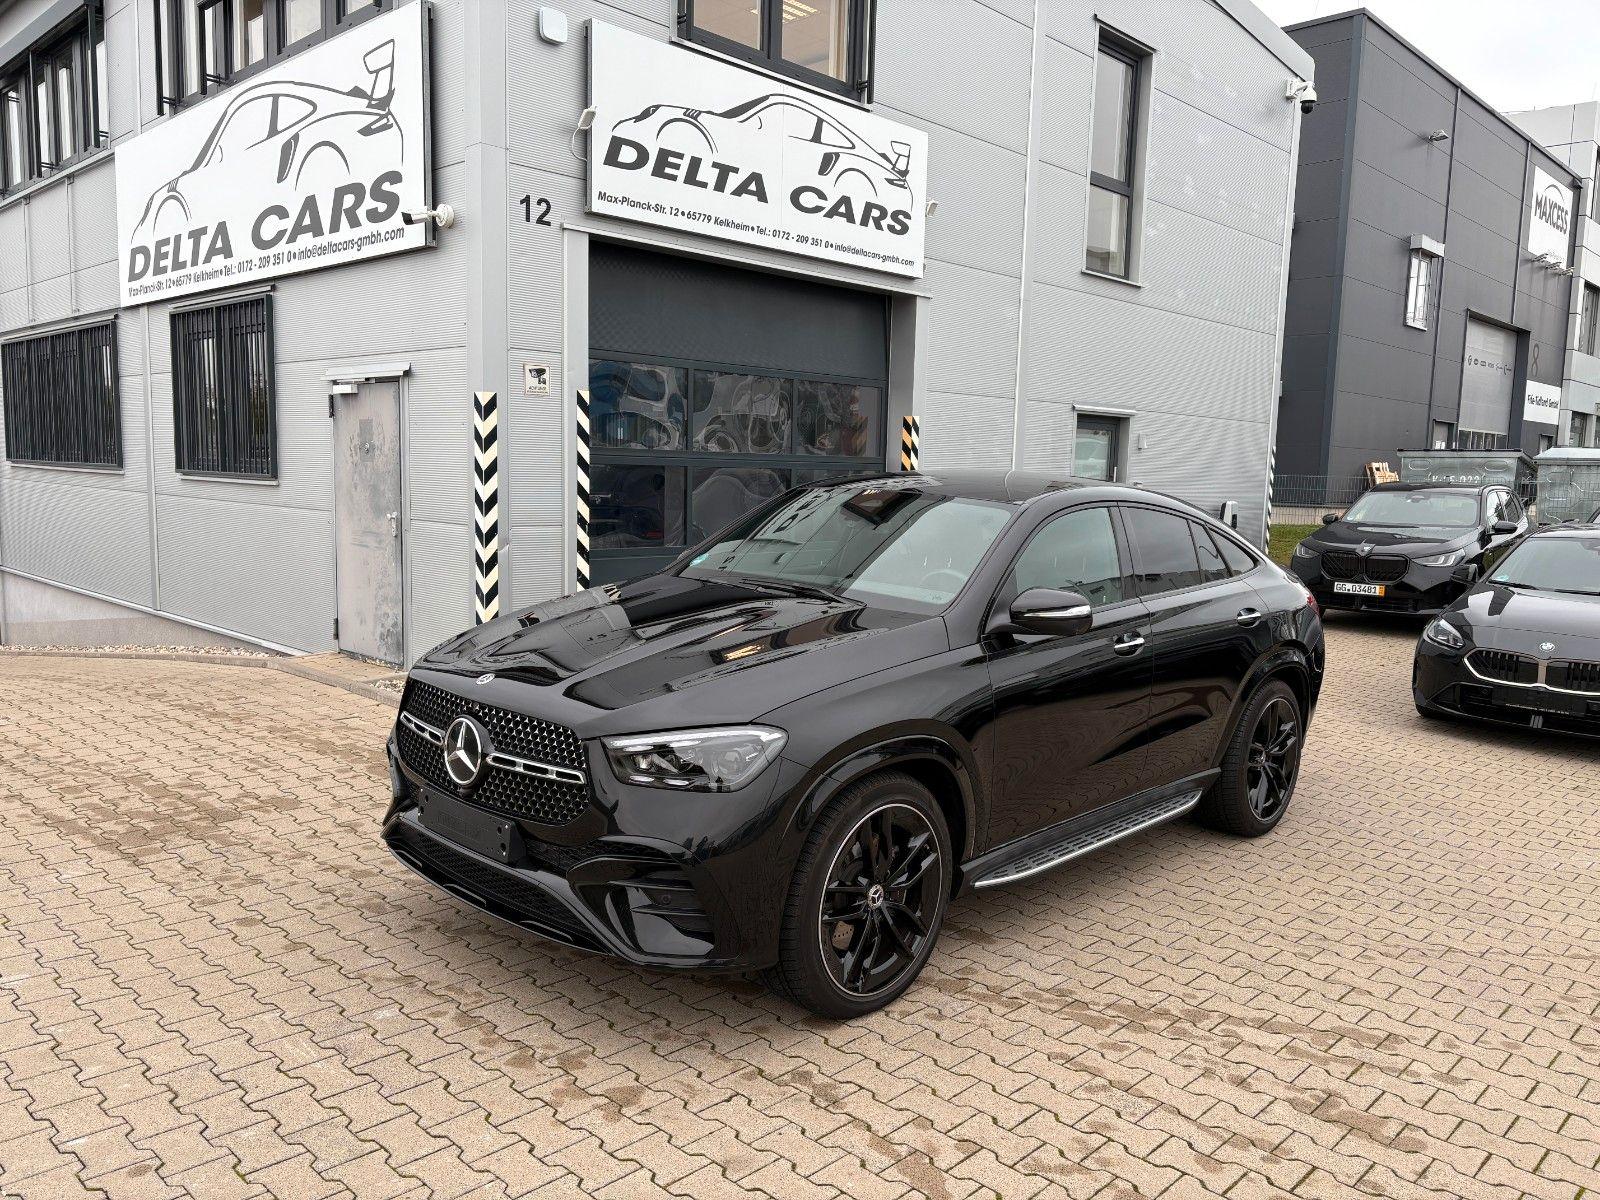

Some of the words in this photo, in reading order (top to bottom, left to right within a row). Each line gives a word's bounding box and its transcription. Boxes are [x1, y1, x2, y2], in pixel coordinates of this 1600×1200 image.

[602, 135, 769, 203] DELTA
[789, 185, 912, 236] CARS
[128, 220, 234, 283] DELTA
[251, 170, 403, 251] CARS
[519, 194, 552, 227] 12
[597, 190, 667, 215] Max-Planck-Str.
[686, 210, 712, 224] 65779
[713, 216, 750, 232] Kelkheim
[772, 229, 790, 241] 0172
[795, 234, 809, 244] 209
[810, 237, 823, 248] 351
[834, 243, 915, 267] info@deltacars-gmbh.com
[1534, 192, 1569, 234] MAXCESS
[237, 259, 253, 274] 0172
[258, 256, 271, 269] 209
[272, 254, 285, 266] 351
[297, 226, 405, 261] info@deltacars-gmbh.com
[1531, 343, 1540, 377] 8
